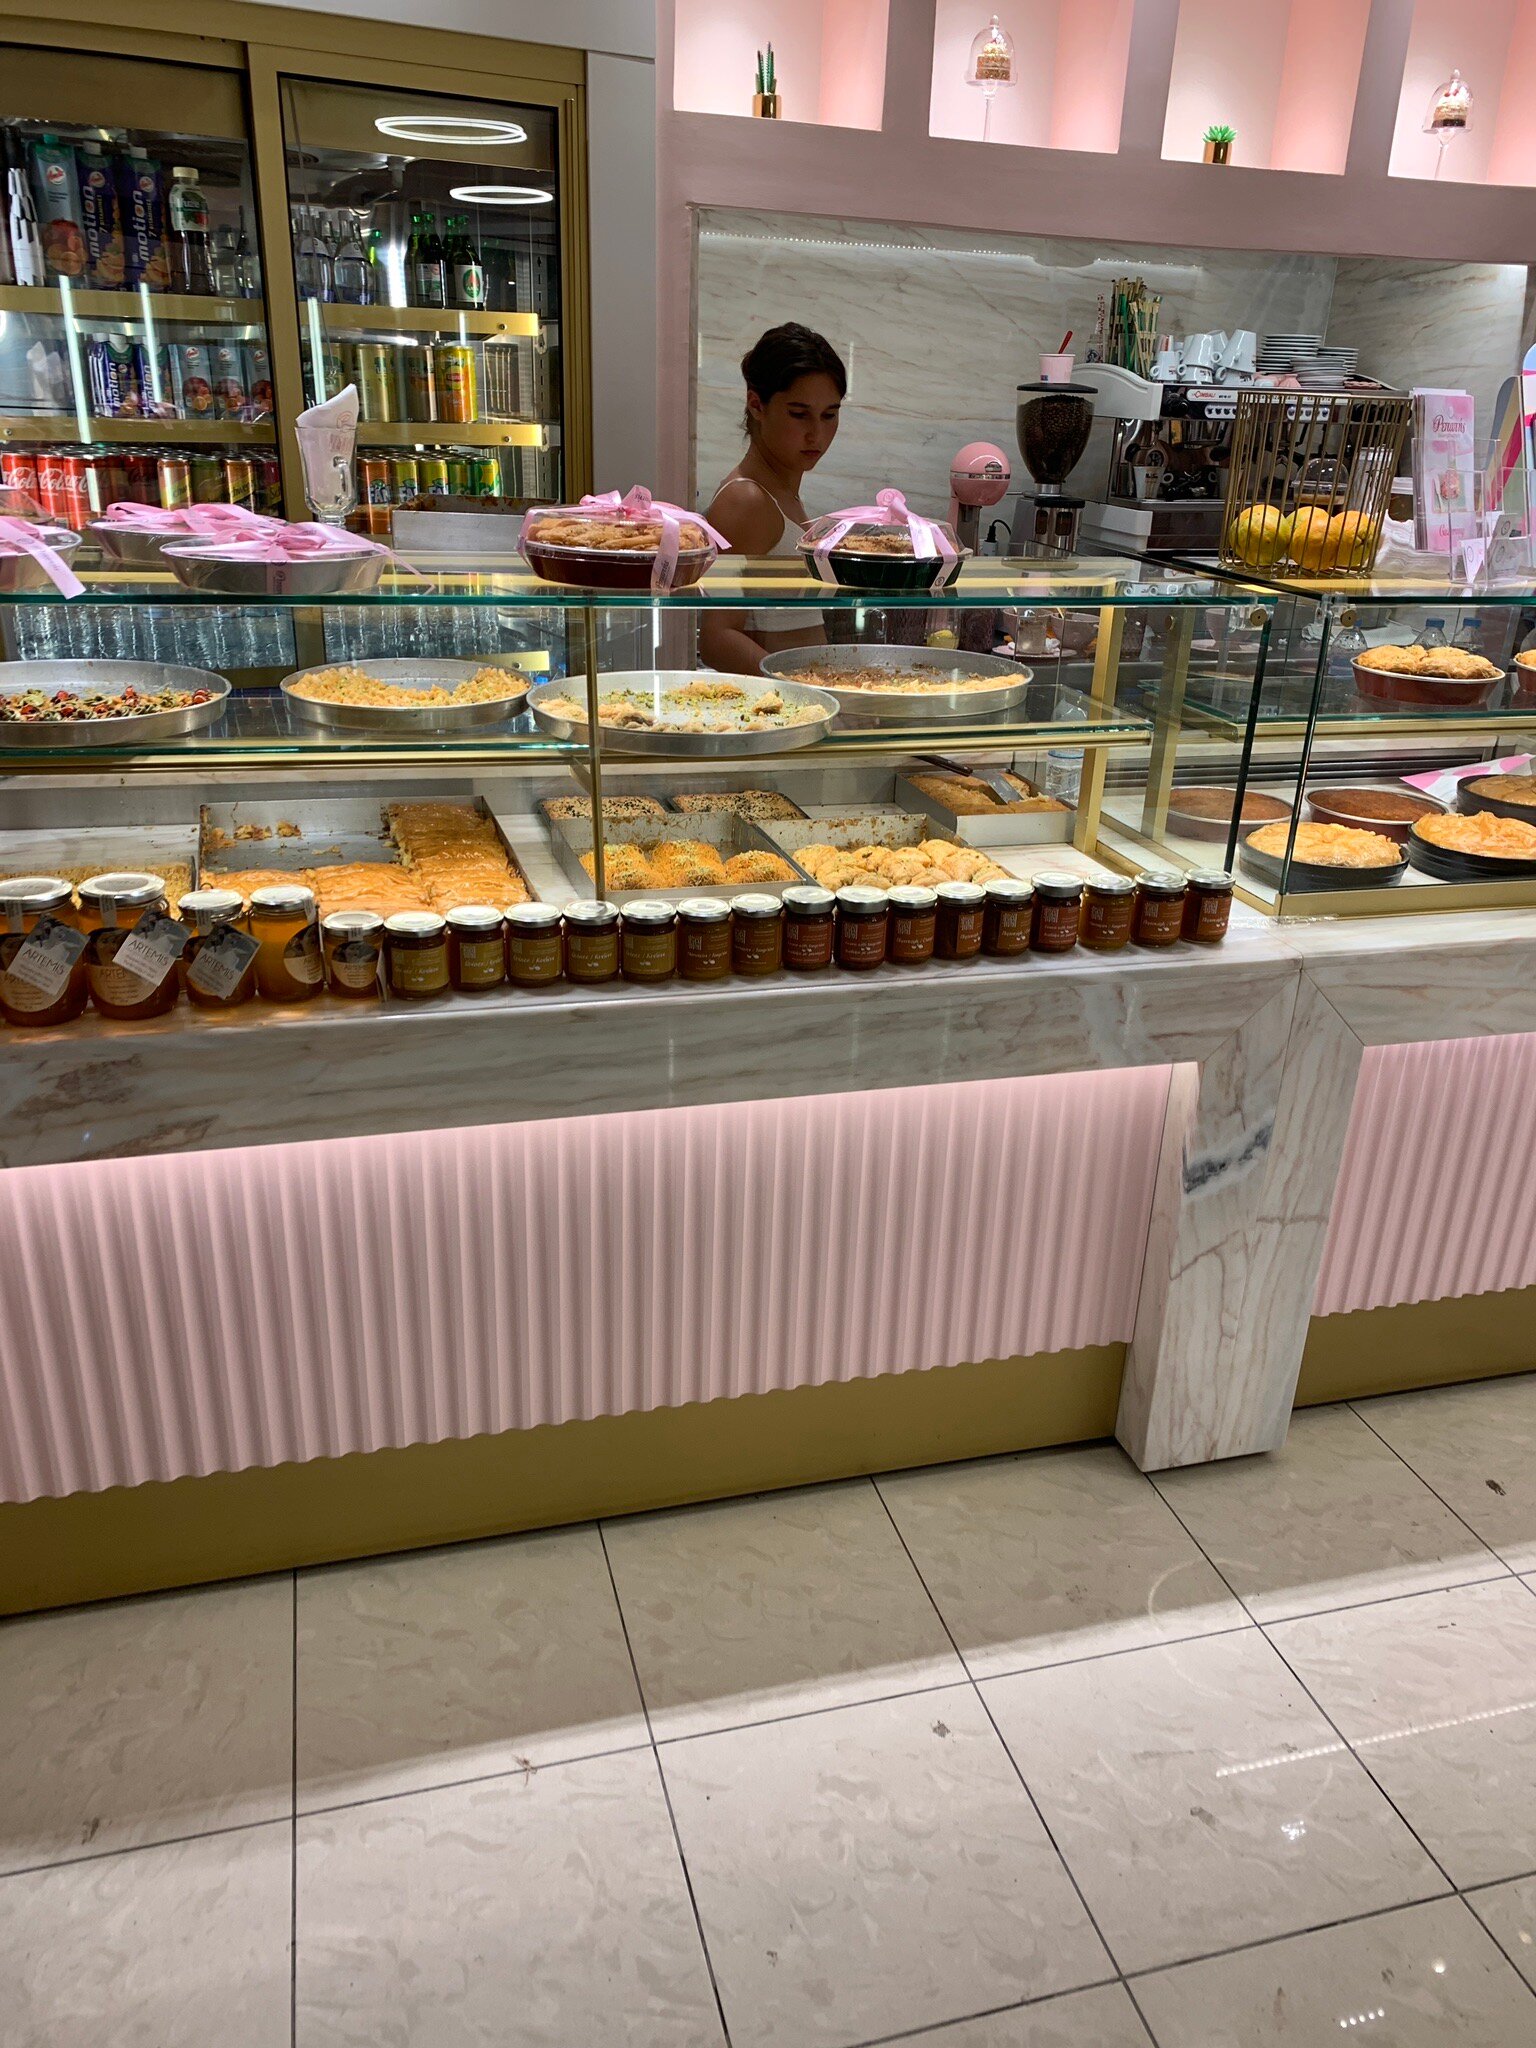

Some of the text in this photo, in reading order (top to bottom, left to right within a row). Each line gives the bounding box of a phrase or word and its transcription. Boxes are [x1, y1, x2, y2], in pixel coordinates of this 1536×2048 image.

[83, 185, 101, 258] motion
[132, 190, 150, 262] motion
[109, 362, 121, 408] motion
[22, 948, 65, 976] ARTEMIS
[128, 938, 170, 968] ARTEMIS
[200, 952, 235, 982] ARTEMIS
